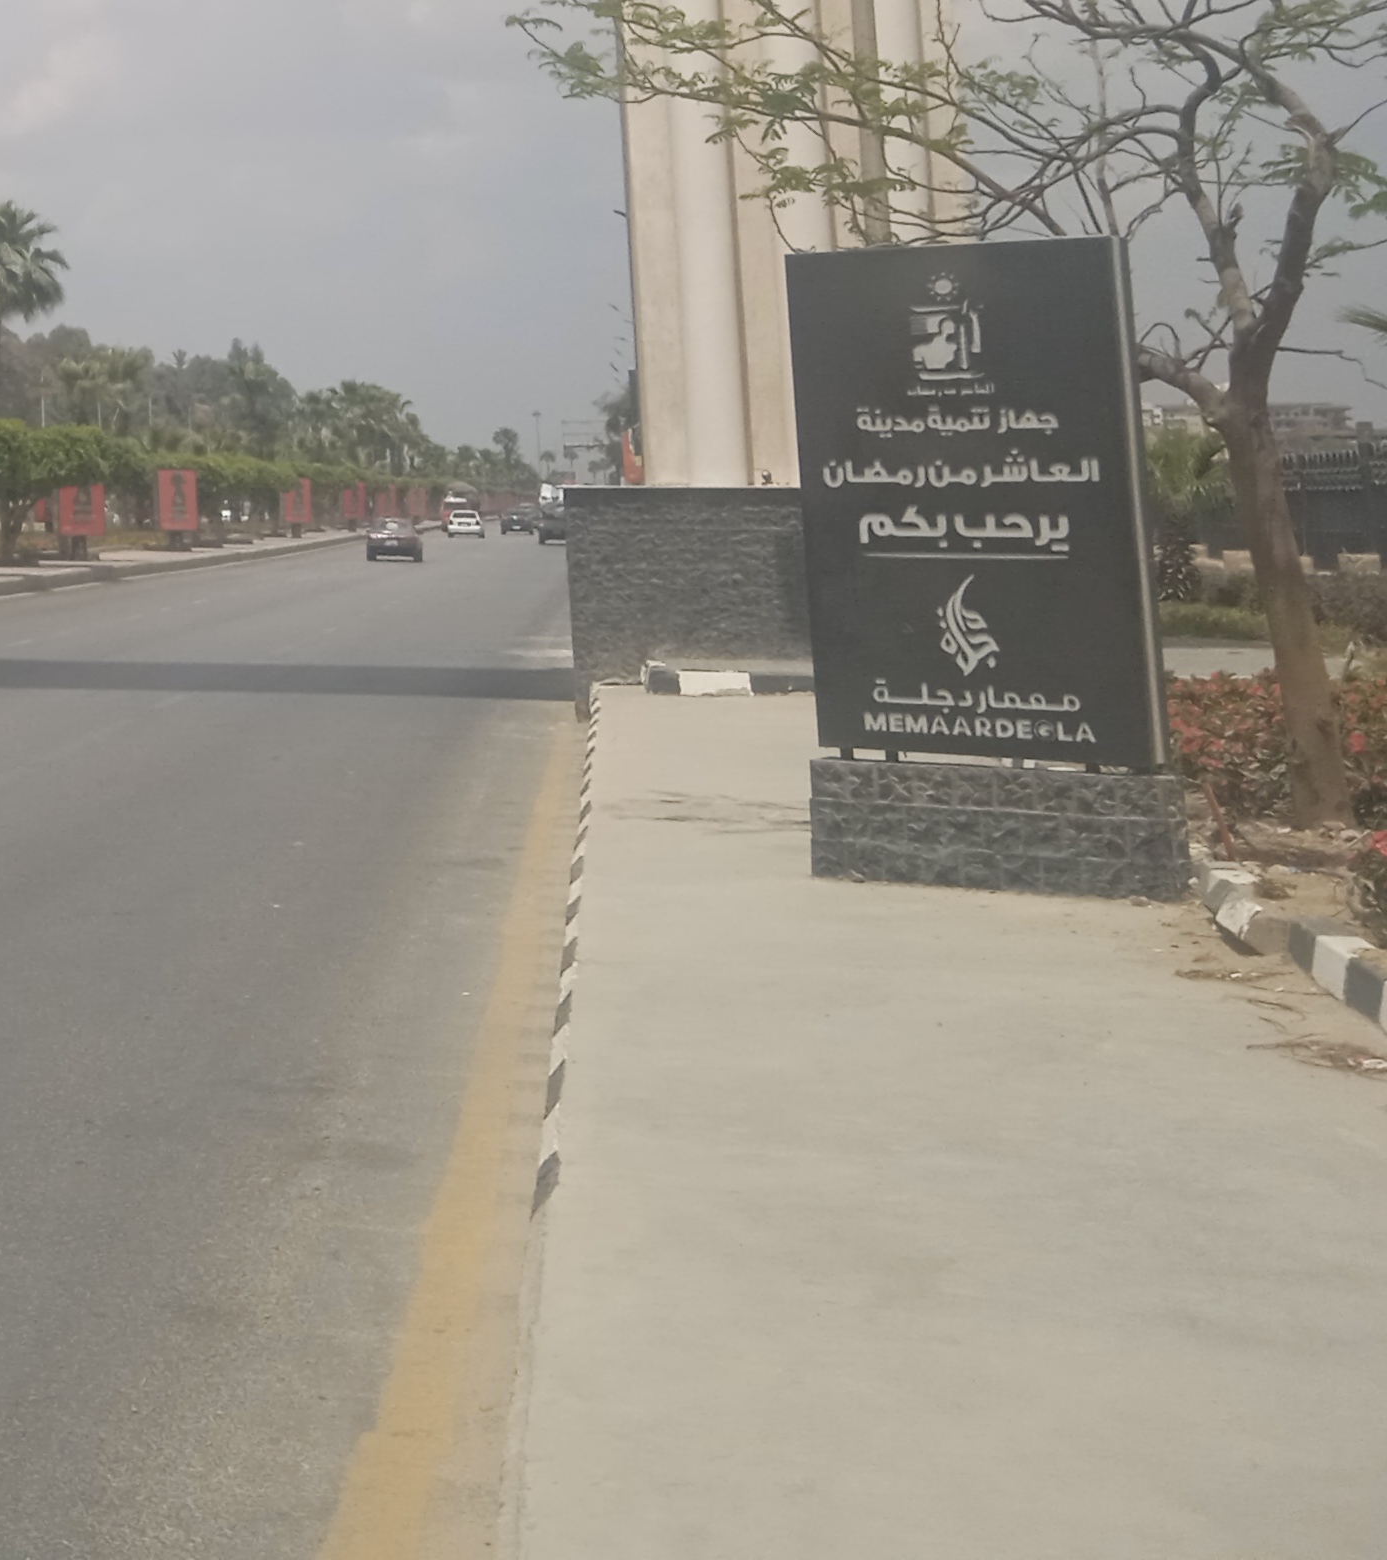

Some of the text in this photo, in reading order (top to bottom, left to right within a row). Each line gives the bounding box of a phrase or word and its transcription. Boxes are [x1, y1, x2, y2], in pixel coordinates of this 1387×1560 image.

[856, 405, 1060, 439] جهاز تنمية مدينة
[823, 447, 1101, 489] العاشر من رمضان
[859, 505, 1070, 552] يرحب بكم
[872, 678, 1082, 714] معمار دجلة
